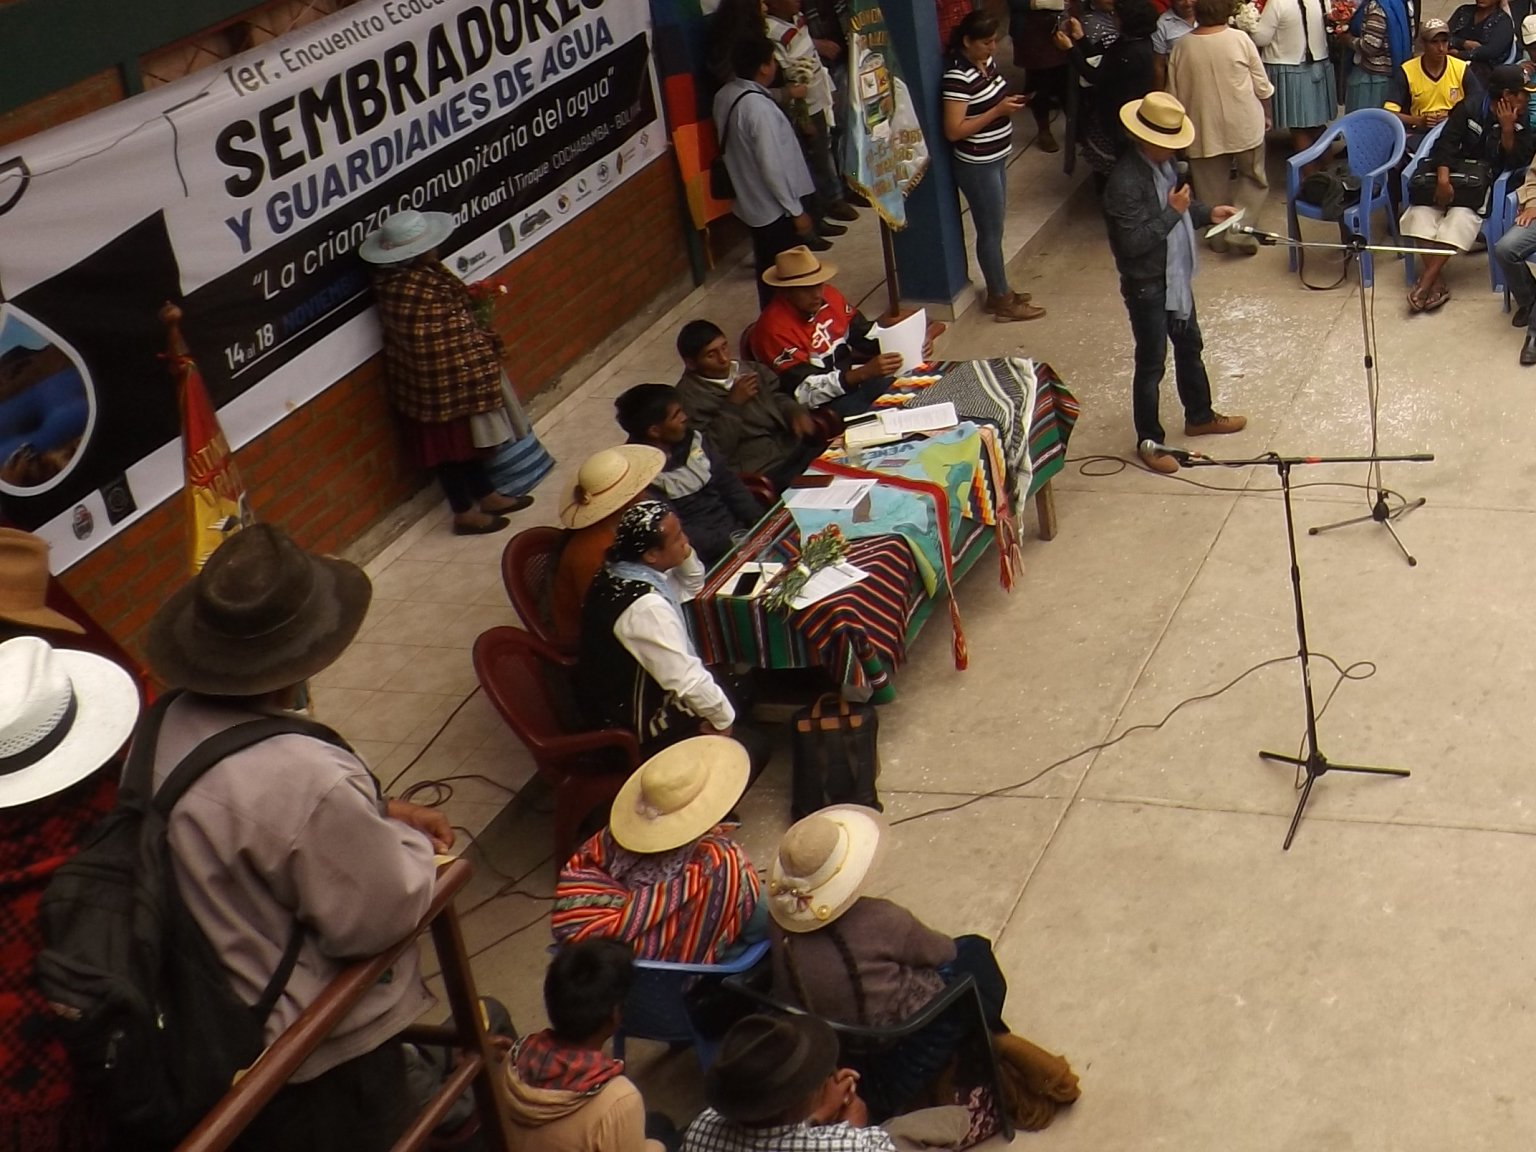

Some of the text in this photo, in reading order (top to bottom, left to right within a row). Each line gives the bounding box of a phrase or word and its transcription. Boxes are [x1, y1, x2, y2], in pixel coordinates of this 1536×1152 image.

[224, 63, 281, 98] 1er.
[280, 13, 385, 73] Encuentro
[225, 206, 254, 254] Y
[265, 81, 493, 236] GUARDIANES
[492, 56, 535, 110] DE
[539, 15, 615, 84] AGUA
[470, 179, 508, 219] Koari
[513, 161, 550, 192] Tiraque
[552, 123, 611, 170] COCHABAMBA
[303, 204, 392, 276] crianza
[397, 124, 529, 212] comunitaria
[532, 97, 565, 138] del
[224, 342, 246, 370] 14
[247, 344, 256, 359] al
[256, 323, 275, 350] 18
